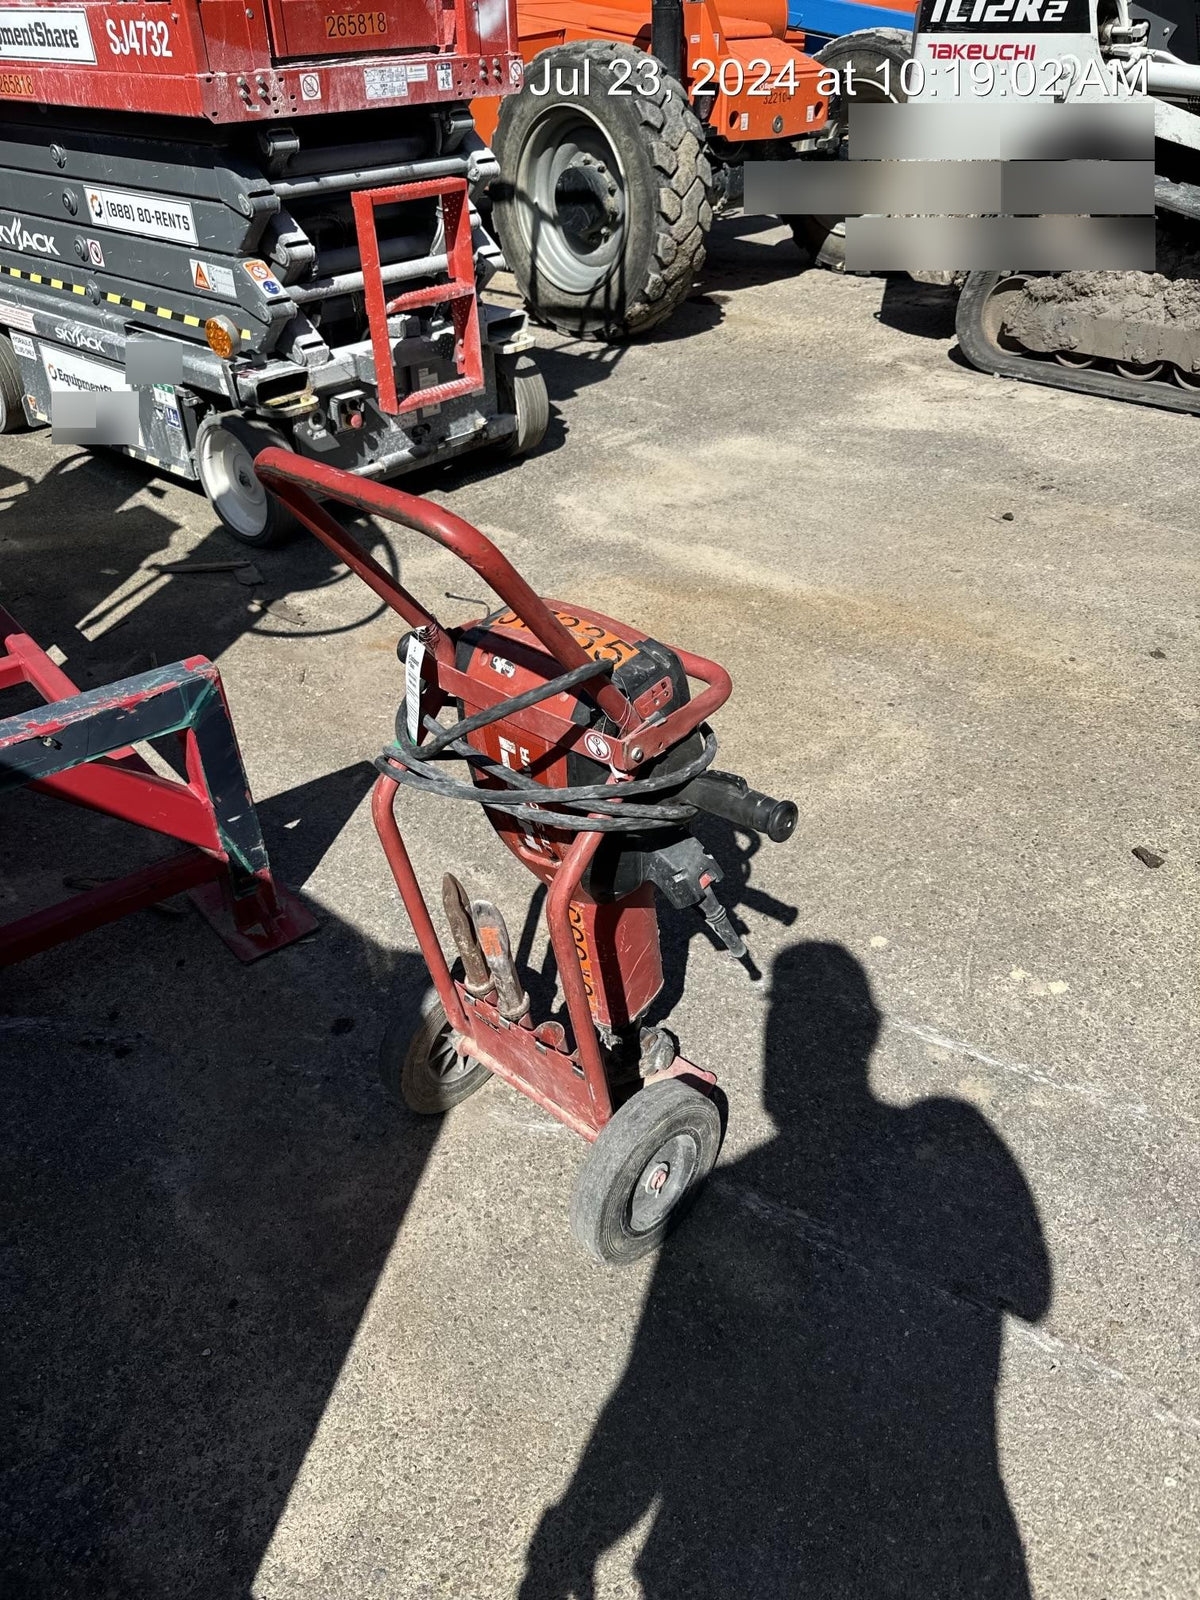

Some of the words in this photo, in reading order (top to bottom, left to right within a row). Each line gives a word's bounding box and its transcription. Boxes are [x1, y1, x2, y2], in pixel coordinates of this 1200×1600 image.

[0, 22, 79, 48] mentShare
[106, 19, 173, 57] SJ4732
[326, 12, 387, 38] 265818
[106, 200, 136, 222] (888)
[54, 325, 105, 353] SKYJACK
